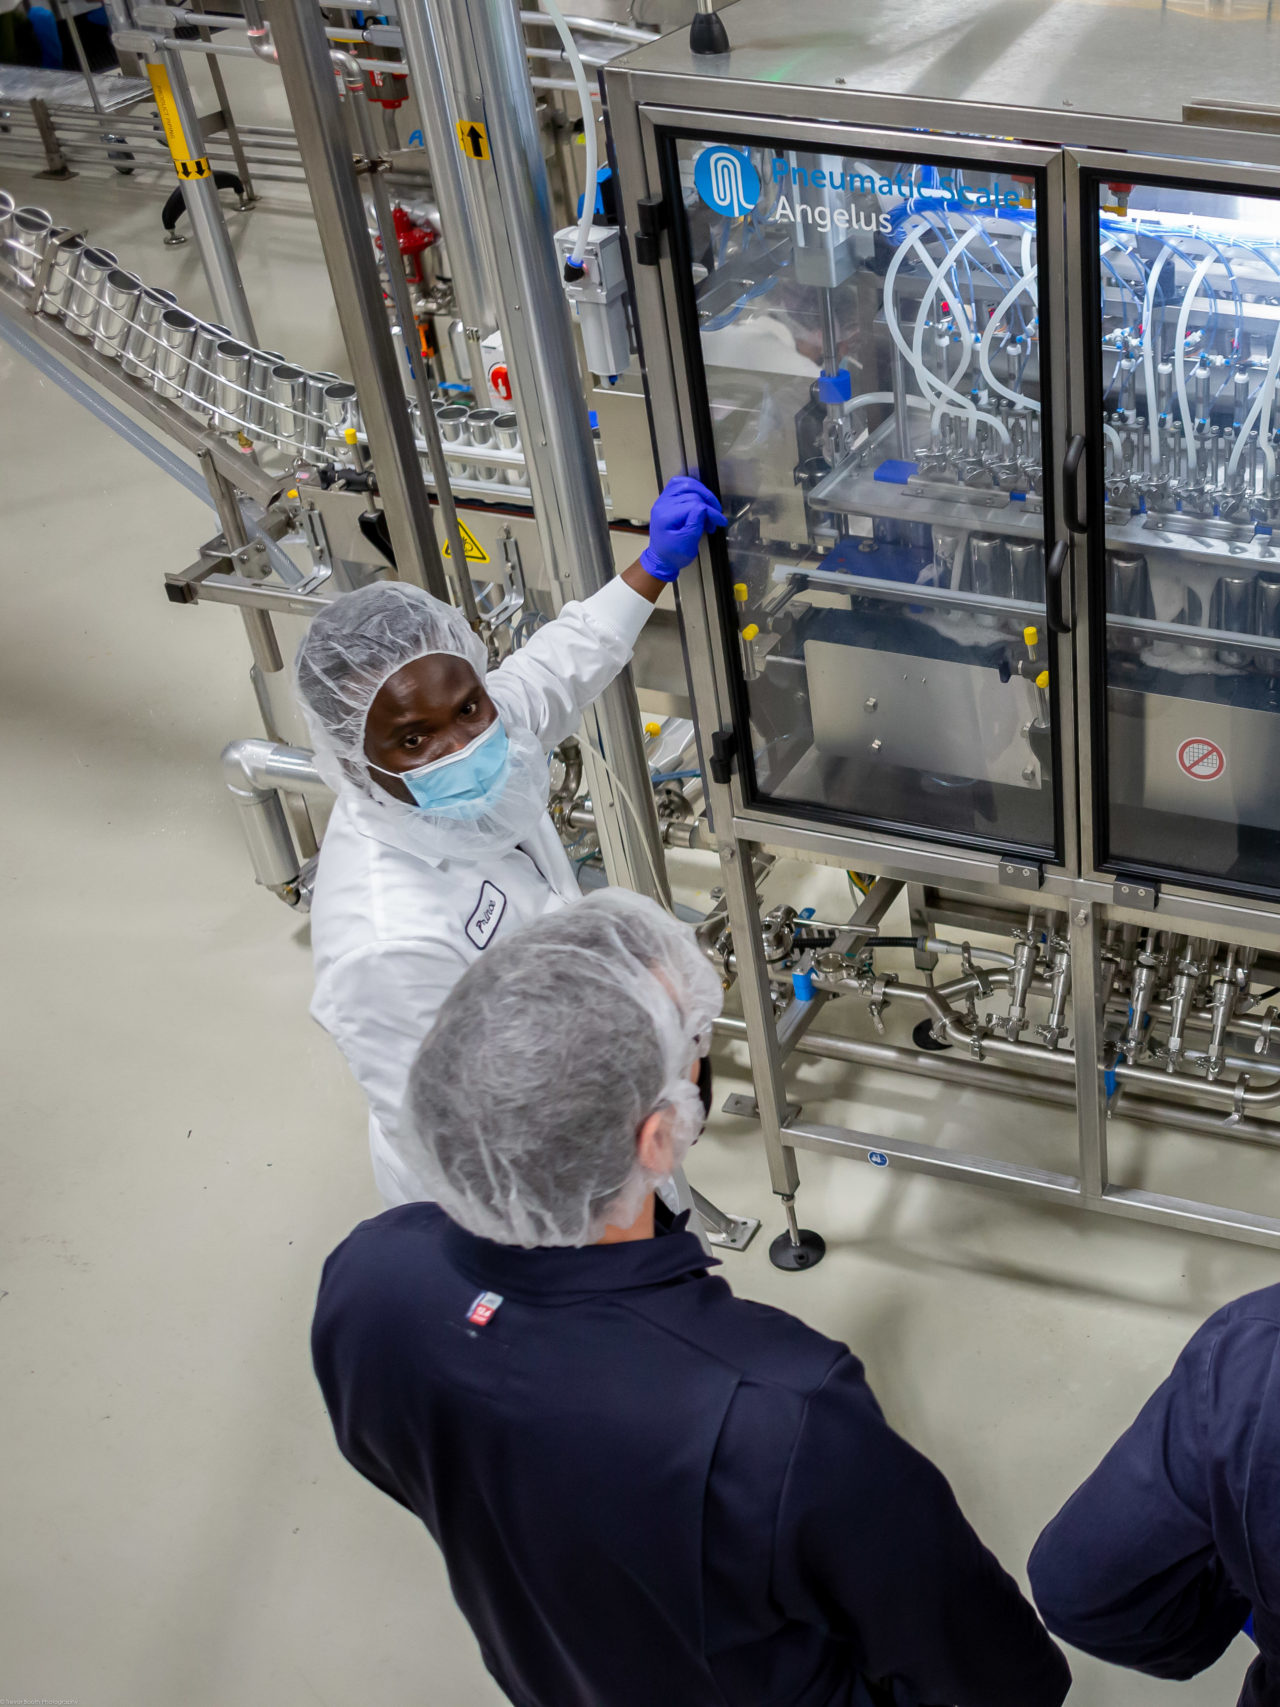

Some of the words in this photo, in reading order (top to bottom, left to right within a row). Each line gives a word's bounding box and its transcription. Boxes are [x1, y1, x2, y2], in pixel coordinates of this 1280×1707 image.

[772, 158, 932, 200] Pneumatic
[940, 176, 1020, 210] Scale
[775, 195, 893, 234] Angelus
